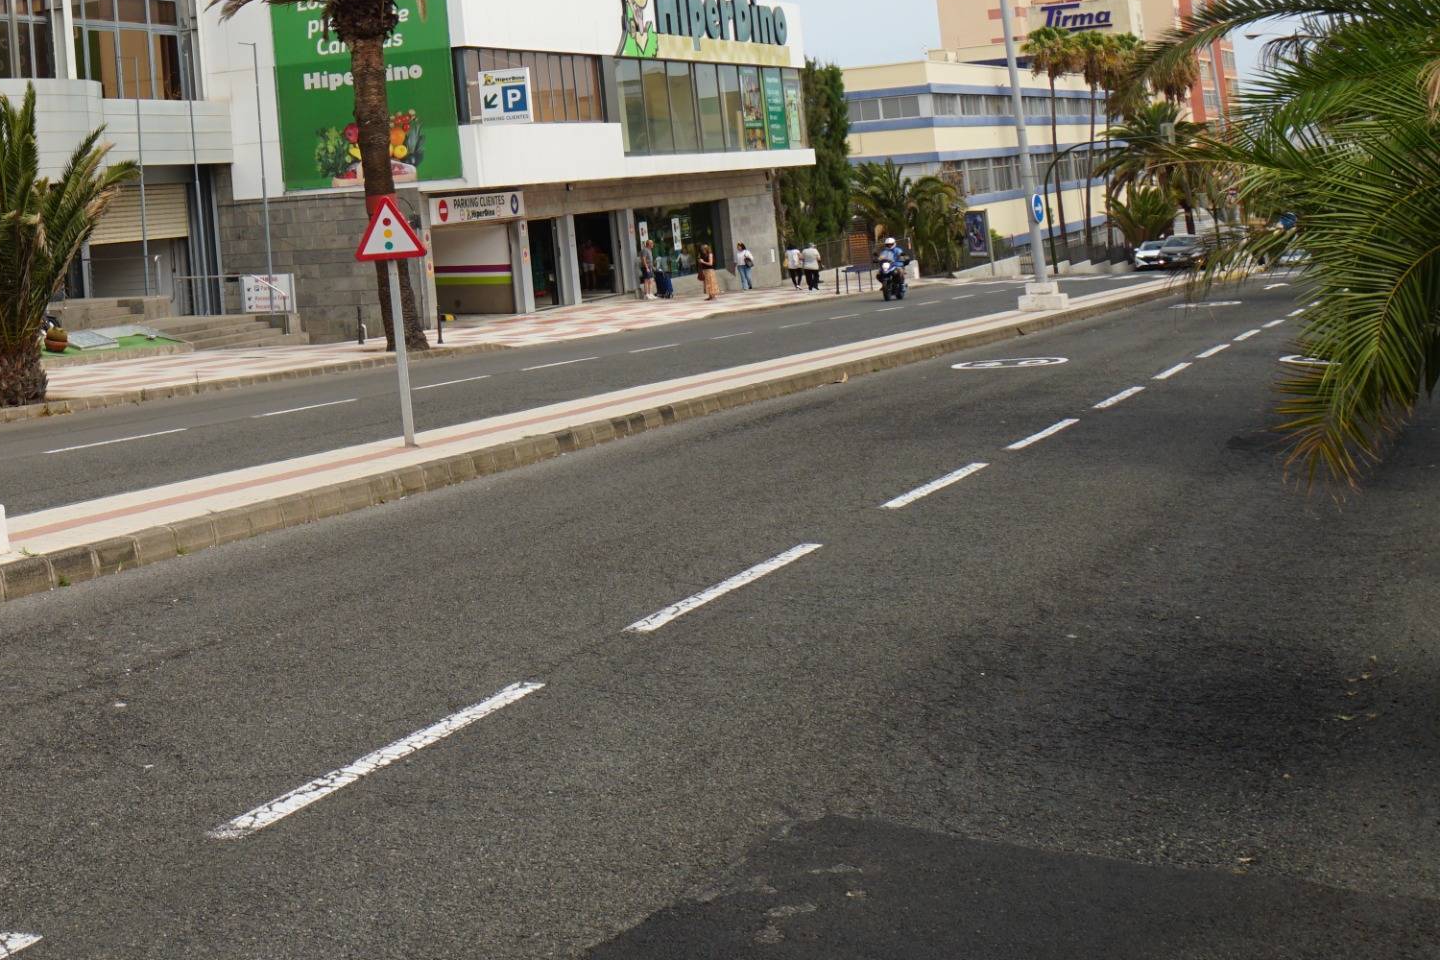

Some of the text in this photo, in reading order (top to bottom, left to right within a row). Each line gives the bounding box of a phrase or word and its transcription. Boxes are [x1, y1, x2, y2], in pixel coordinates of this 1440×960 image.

[1041, 3, 1112, 29] Tirma
[303, 64, 423, 91] Hipeino
[506, 88, 522, 109] P
[453, 195, 505, 209] PARKING CLIENTES
